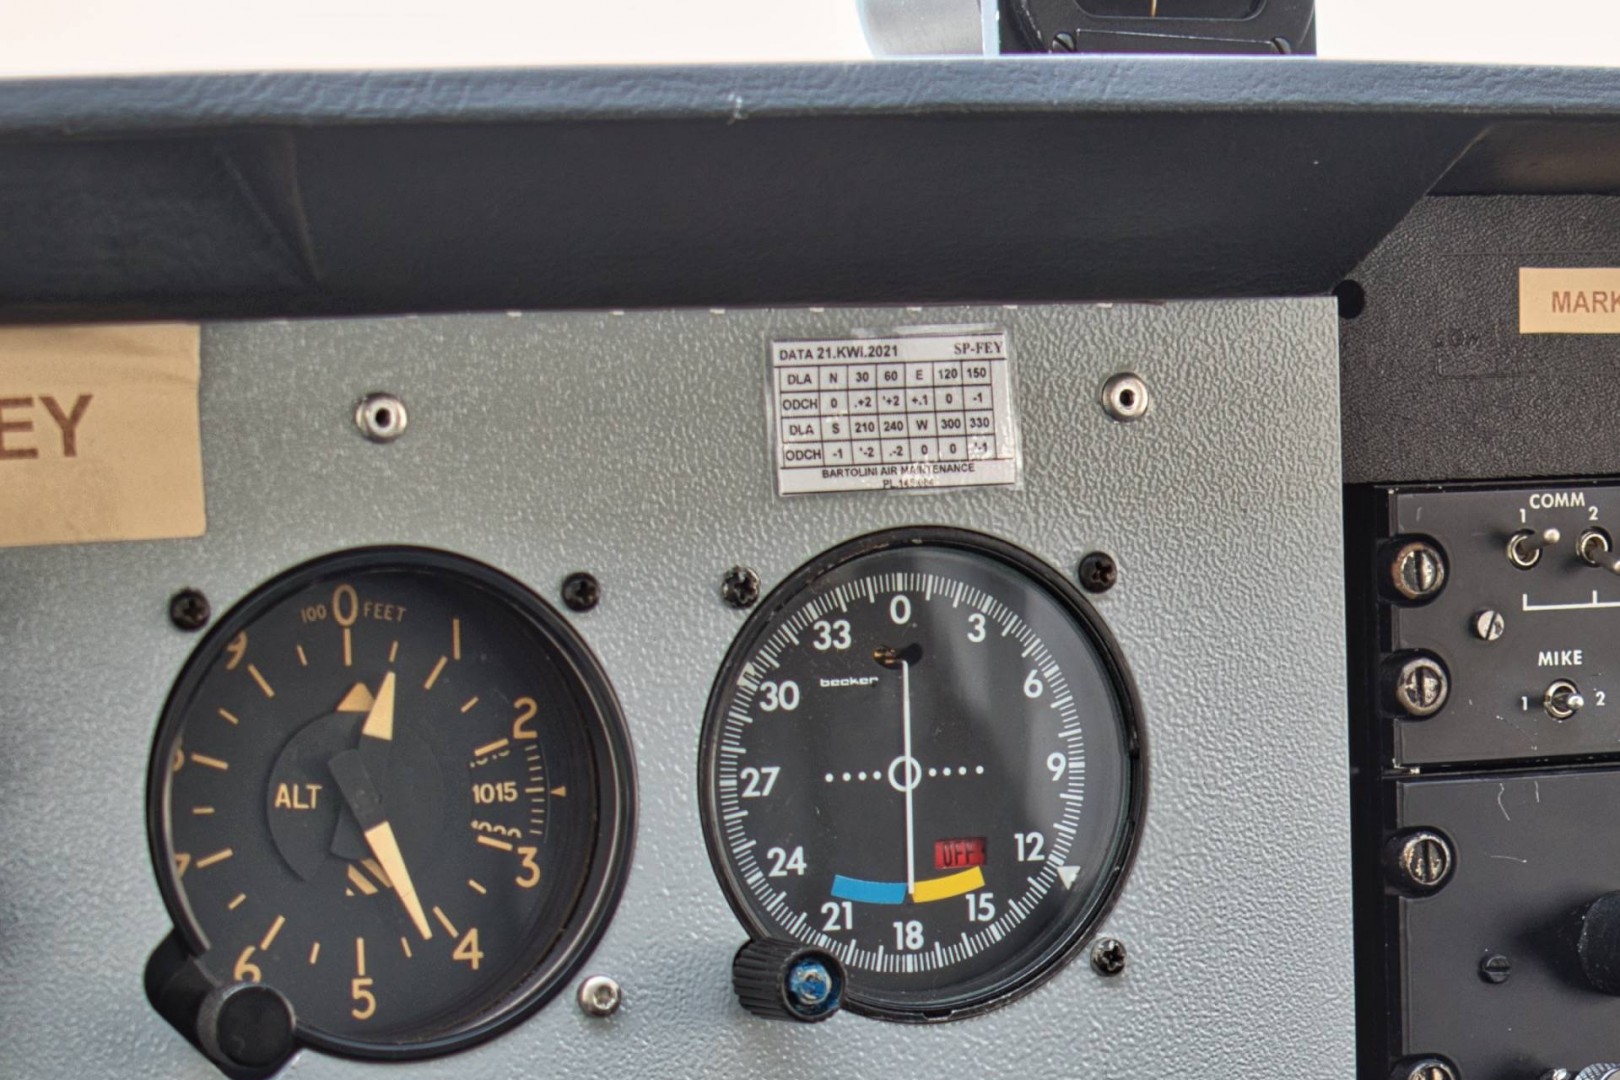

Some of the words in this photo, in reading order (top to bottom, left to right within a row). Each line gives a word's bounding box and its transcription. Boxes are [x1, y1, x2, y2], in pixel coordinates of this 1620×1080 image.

[780, 349, 813, 360] DATA
[817, 345, 898, 359] 21.KWI.2021
[954, 341, 1003, 355] SP-FEY
[787, 373, 812, 385] DLA
[830, 373, 837, 383] N
[856, 372, 869, 382] 30
[884, 371, 898, 381] 60
[938, 369, 958, 379] 120
[967, 368, 986, 379] 150
[783, 399, 817, 410] ODCH
[0, 395, 94, 459] EY
[789, 423, 814, 435] DLA
[855, 422, 875, 432] 210
[884, 421, 904, 432] 240
[916, 420, 928, 430] W
[941, 418, 961, 429] 300
[969, 417, 990, 428] 330
[786, 449, 821, 461] ODCH
[822, 468, 877, 478] BARTOLINI
[881, 466, 897, 476] AIR
[900, 463, 975, 475] MAINTENANCE
[1529, 492, 1585, 509] COMM
[1589, 506, 1599, 520] 2
[1519, 509, 1526, 523] 1
[301, 606, 326, 622] 100
[332, 584, 359, 627] 0
[363, 602, 407, 622] FEET
[890, 596, 911, 624] 0
[813, 621, 852, 651] 33
[968, 614, 986, 642] 3
[1538, 650, 1583, 666] MIKE
[820, 675, 878, 687] becker
[1023, 670, 1043, 698] 6
[760, 682, 799, 710] 30
[1521, 697, 1527, 710] 1
[1596, 691, 1605, 706] 2
[513, 697, 537, 739] 2
[1047, 753, 1066, 781] 9
[472, 782, 518, 804] 1015
[742, 767, 780, 796] 27
[275, 785, 321, 810] ALT
[1014, 832, 1045, 862] 12
[516, 846, 540, 889] 3
[767, 847, 807, 877] 24
[821, 902, 853, 931] 21
[967, 894, 995, 922] 15
[453, 928, 483, 970] 4
[894, 922, 923, 949] 18
[235, 946, 262, 983] 6
[352, 979, 375, 1020] 5
